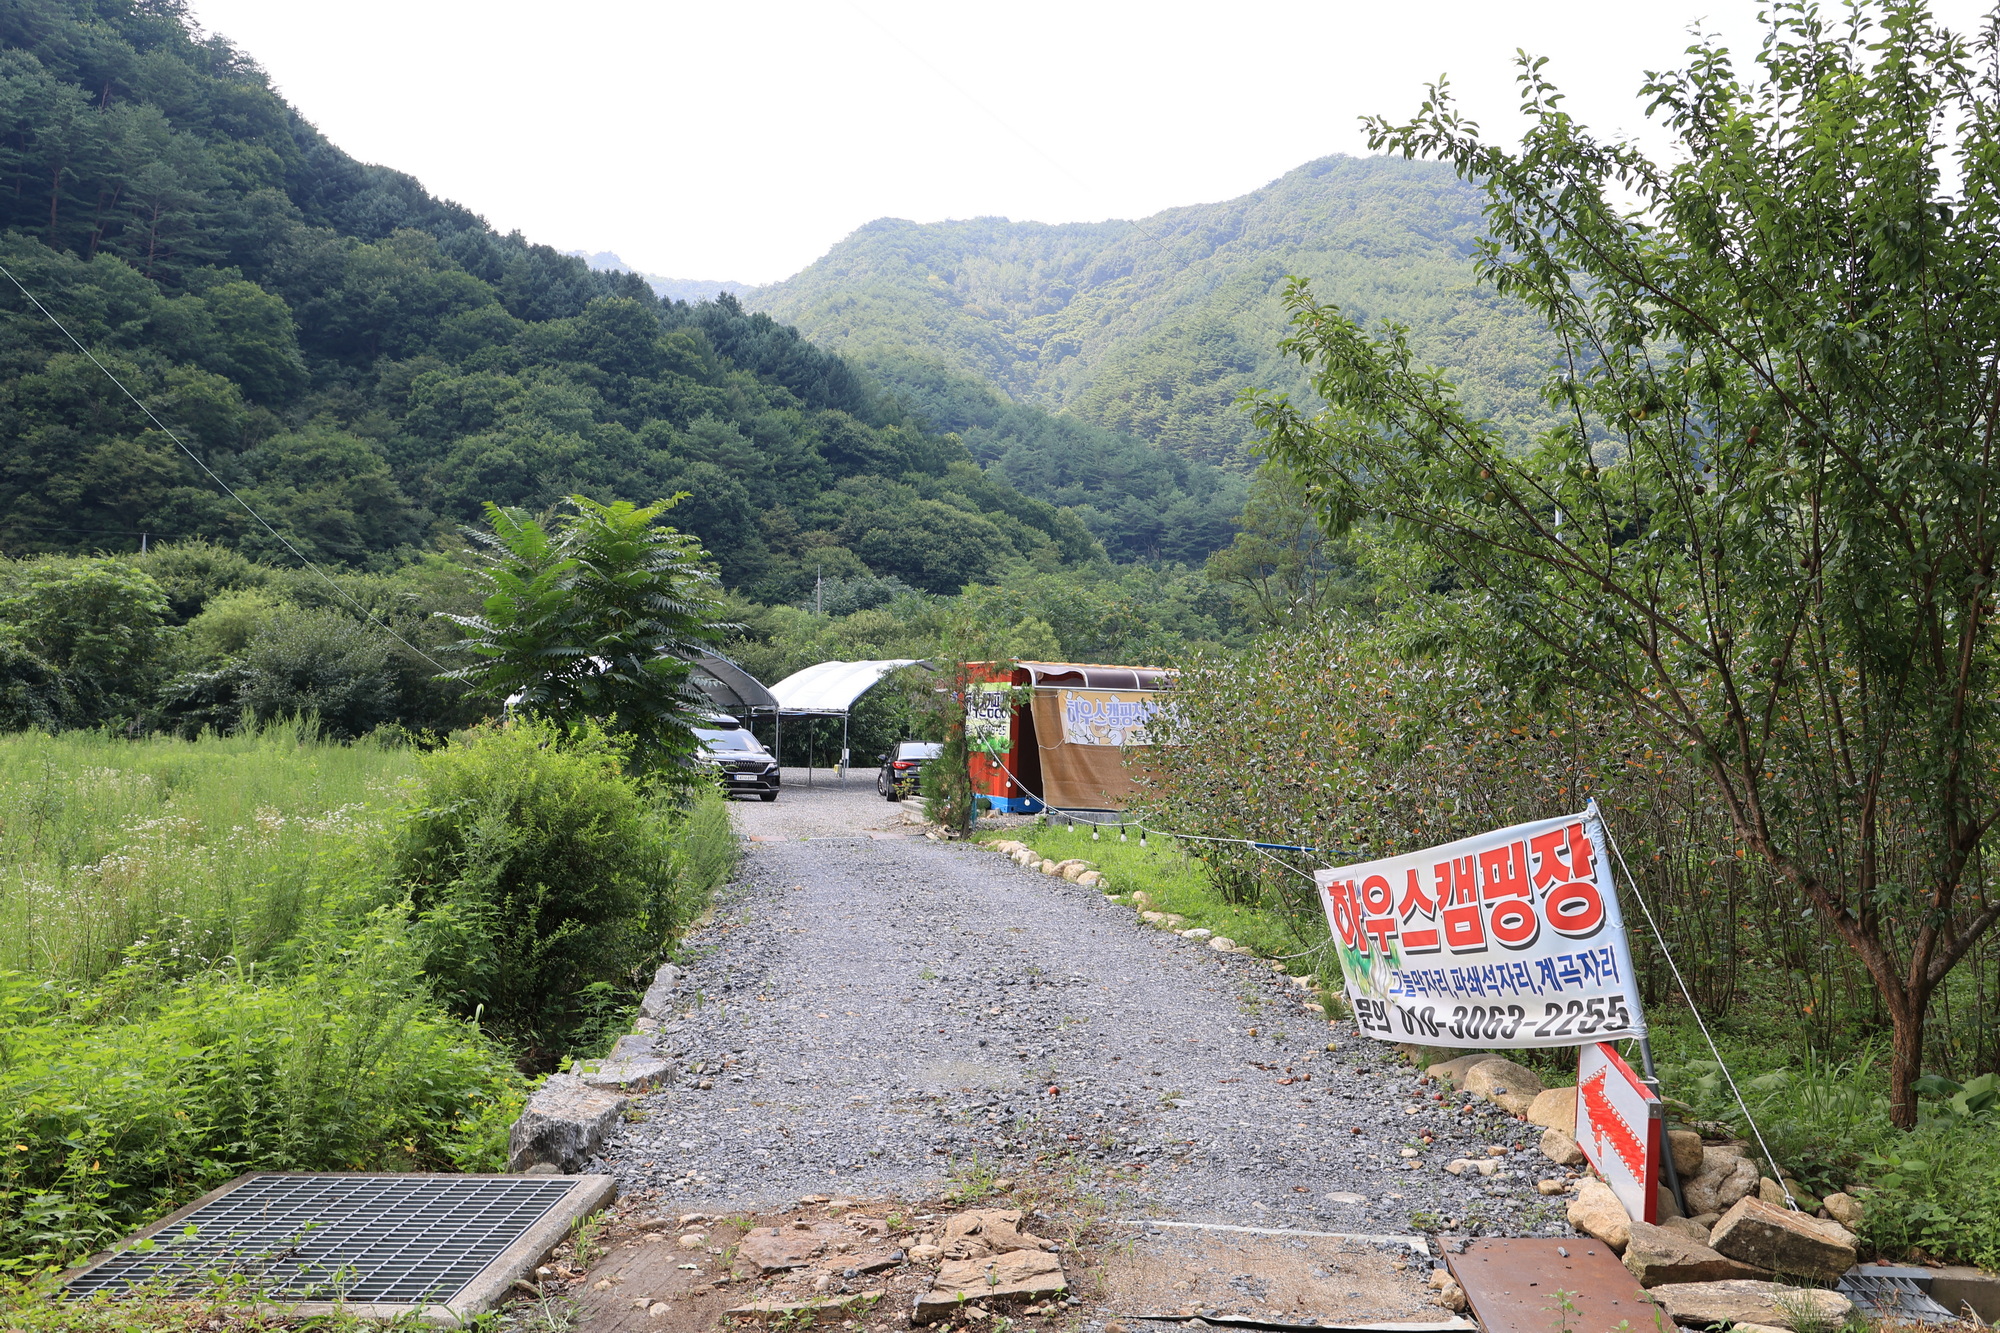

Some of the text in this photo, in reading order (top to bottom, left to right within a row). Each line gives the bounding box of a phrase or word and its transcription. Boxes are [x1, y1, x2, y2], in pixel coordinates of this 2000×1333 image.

[1327, 822, 1606, 960] 하우스캠핑장
[1355, 995, 1630, 1039] 문의 010-3063-2255
